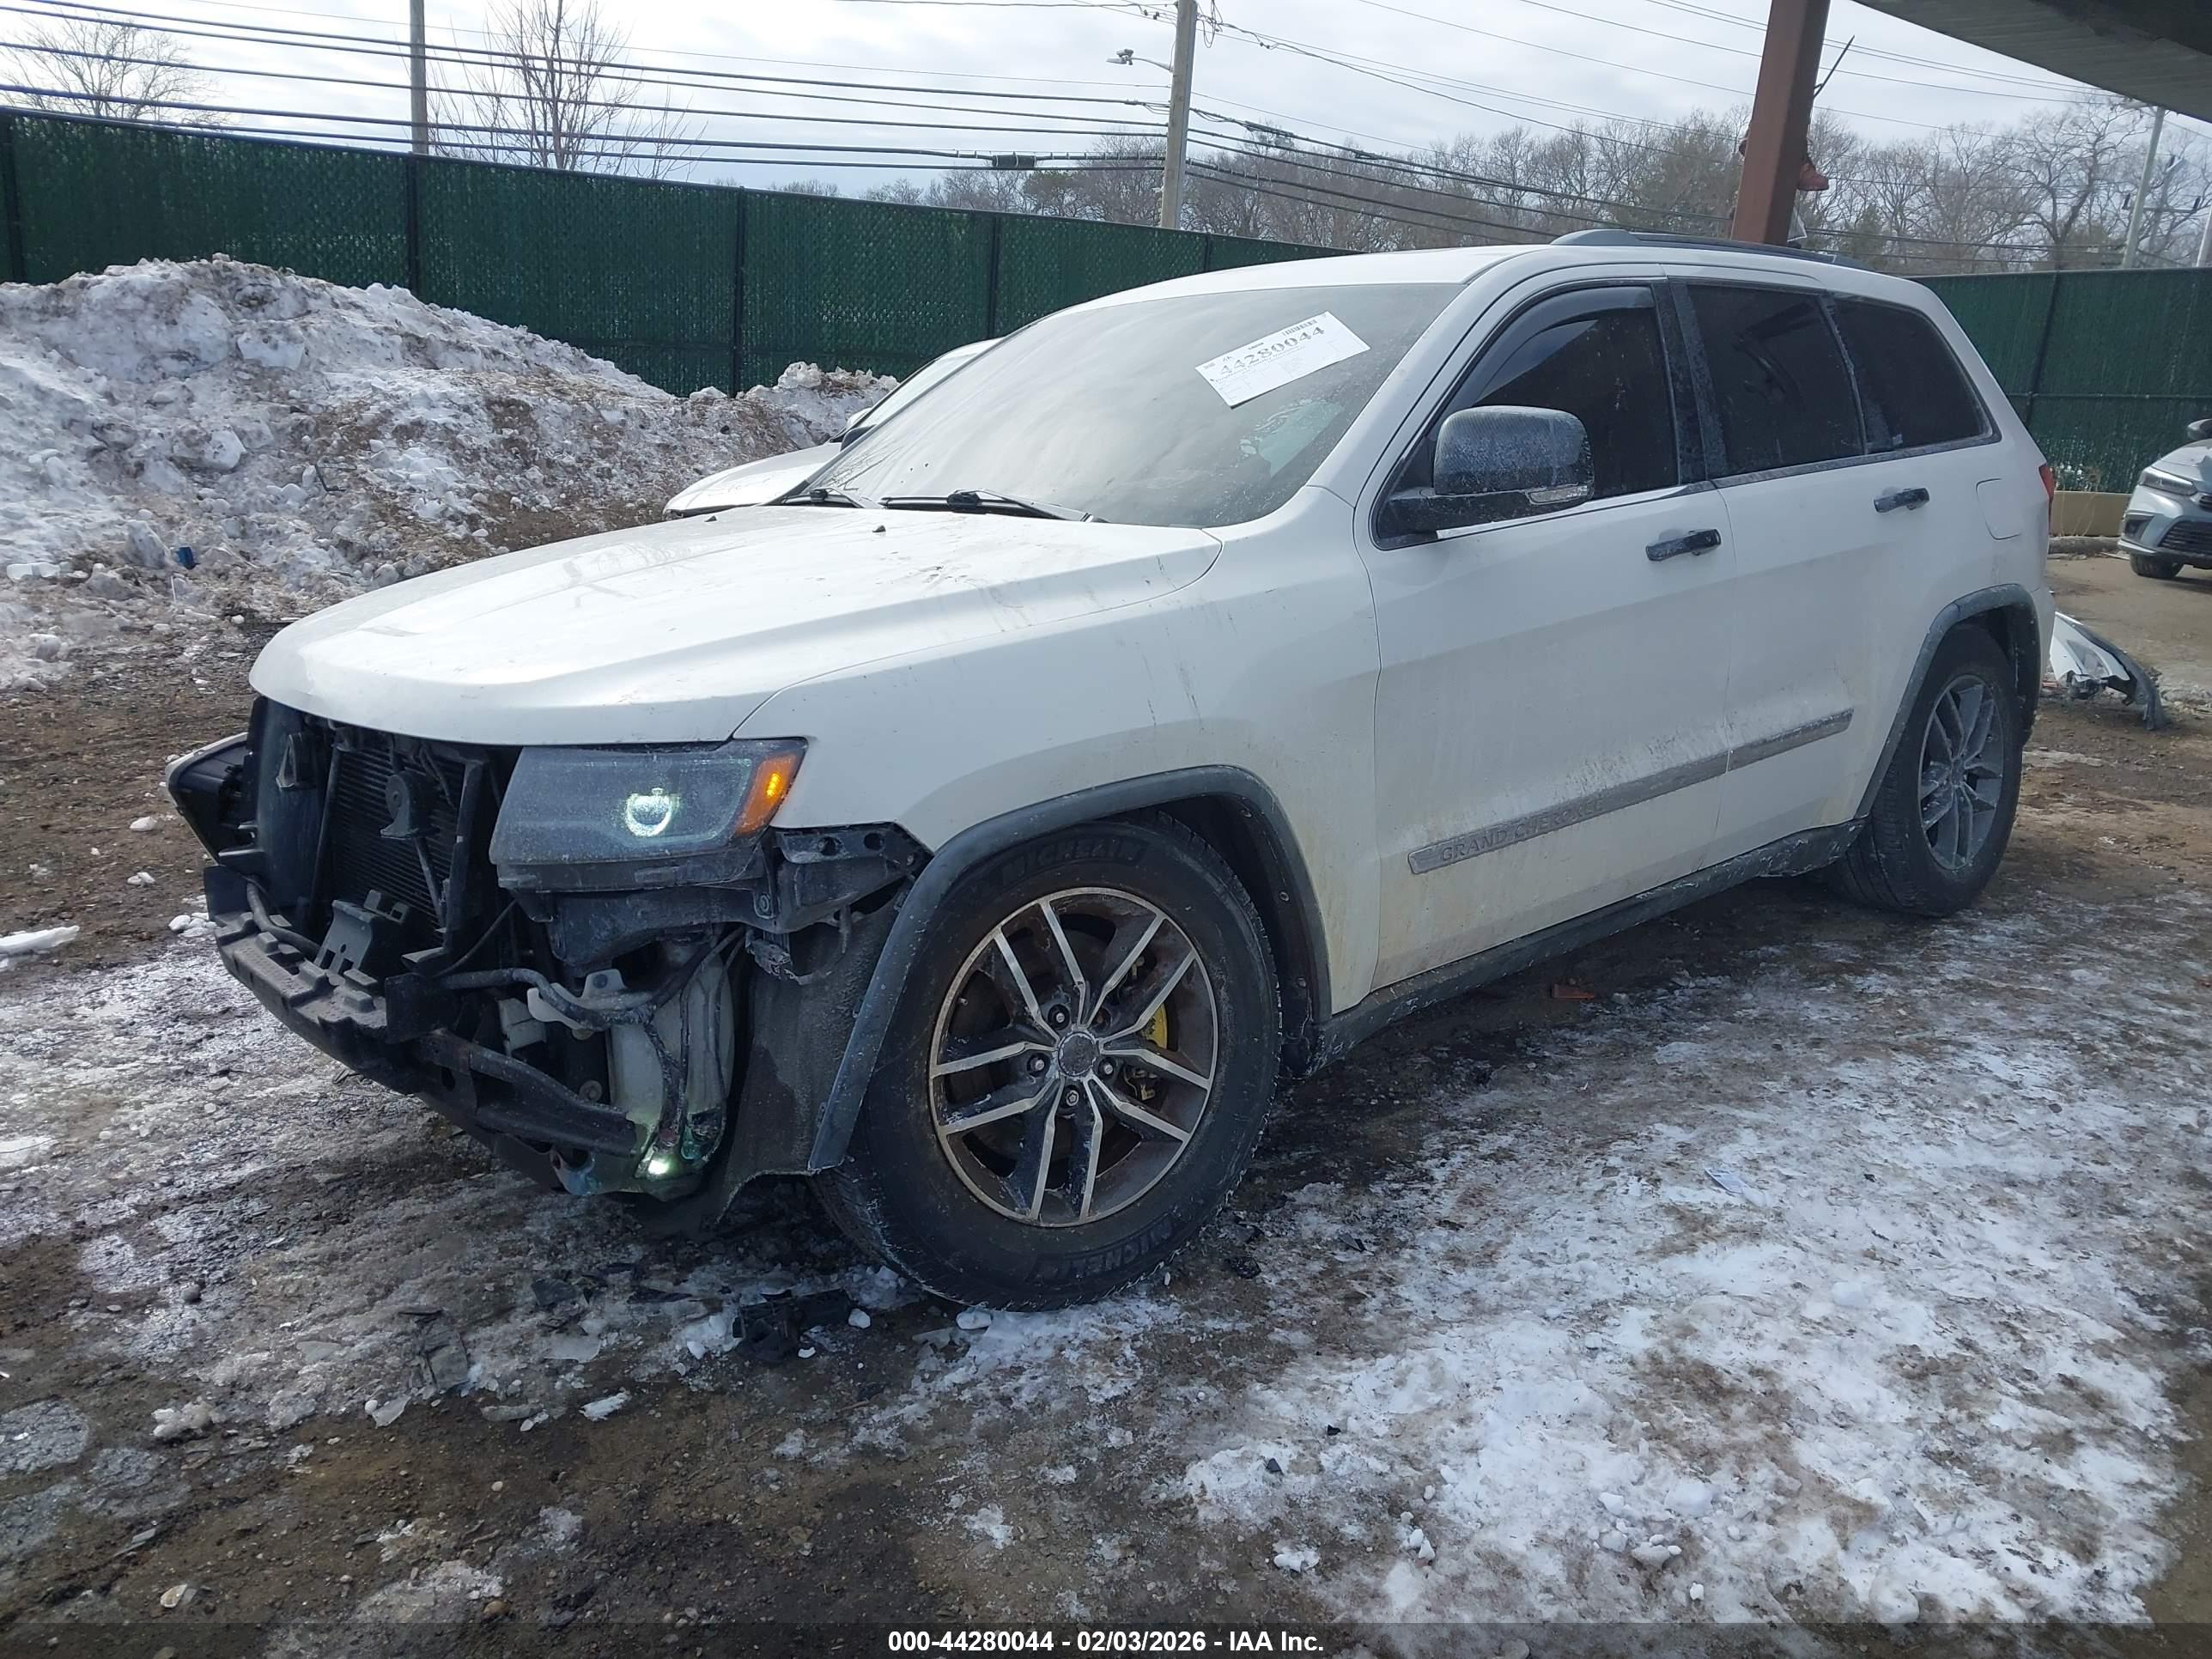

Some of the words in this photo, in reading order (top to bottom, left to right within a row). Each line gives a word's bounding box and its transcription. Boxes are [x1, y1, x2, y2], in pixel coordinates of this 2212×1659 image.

[1219, 325, 1326, 375] 44280044
[1441, 830, 1508, 861] GRAND
[1515, 800, 1604, 837] CHEROKEE
[1004, 837, 1140, 878] MICHELIN
